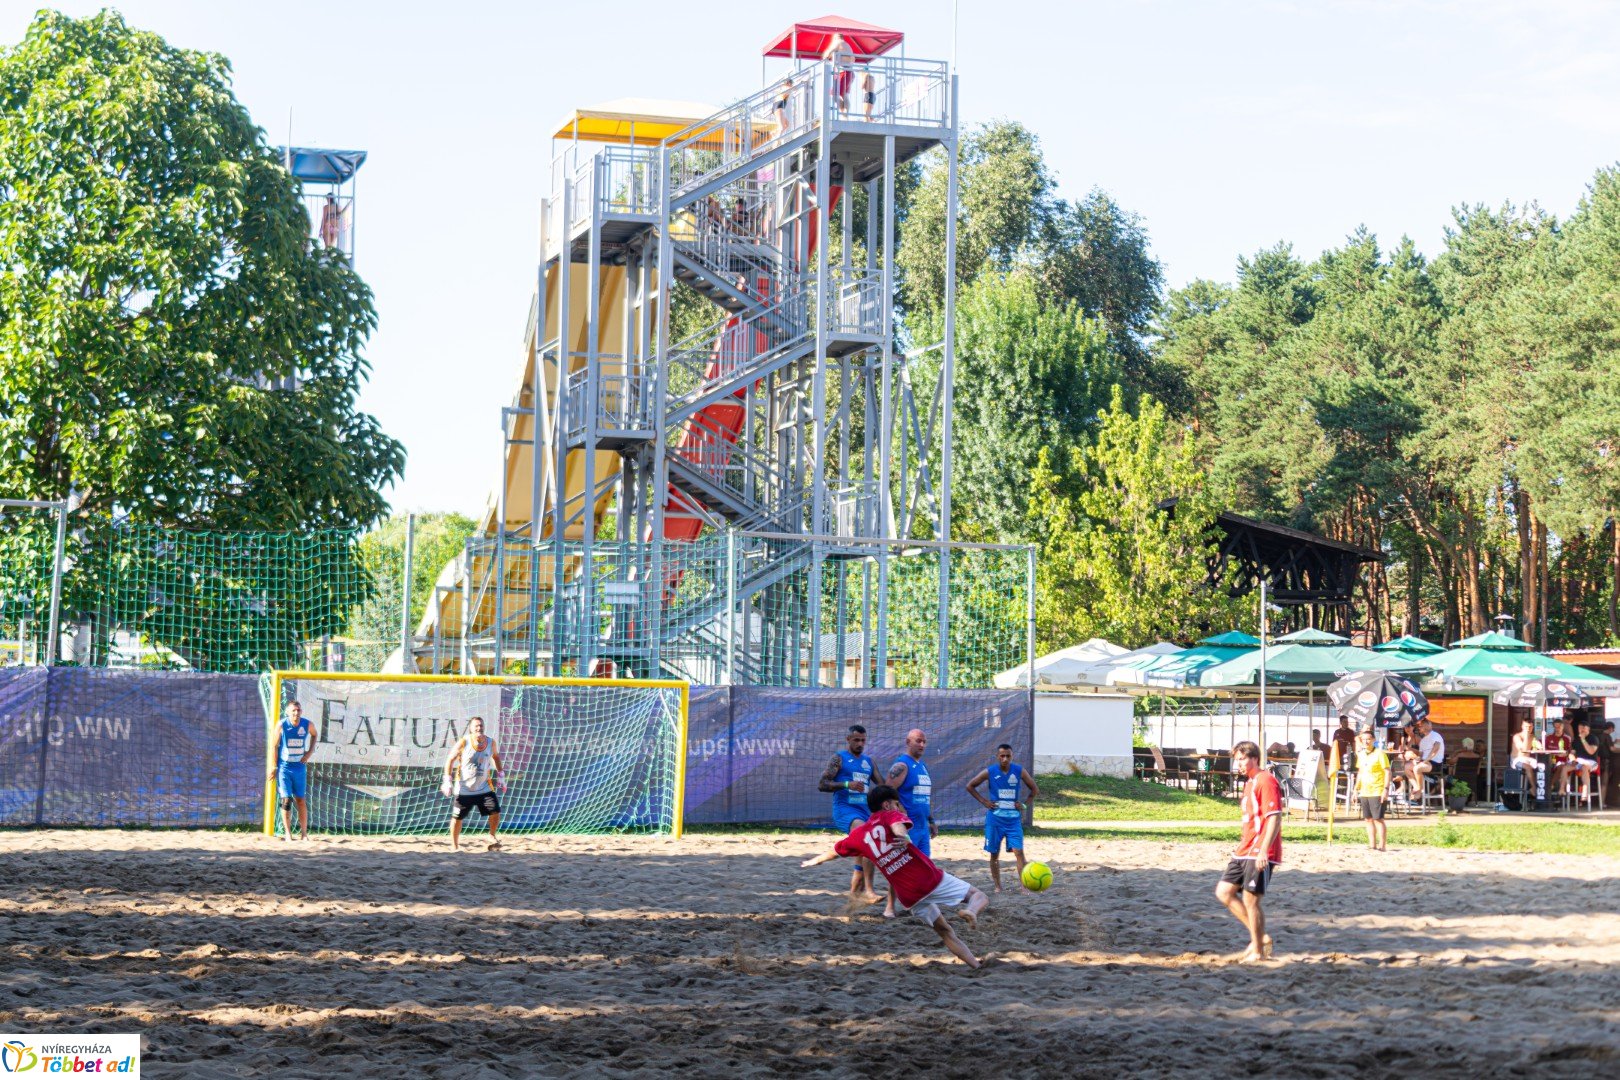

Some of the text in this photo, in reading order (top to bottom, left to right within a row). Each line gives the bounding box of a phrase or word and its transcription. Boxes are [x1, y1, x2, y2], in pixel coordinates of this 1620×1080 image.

[314, 744, 436, 759] ROPER
[1537, 762, 1546, 800] PEPSI
[863, 824, 894, 859] 12
